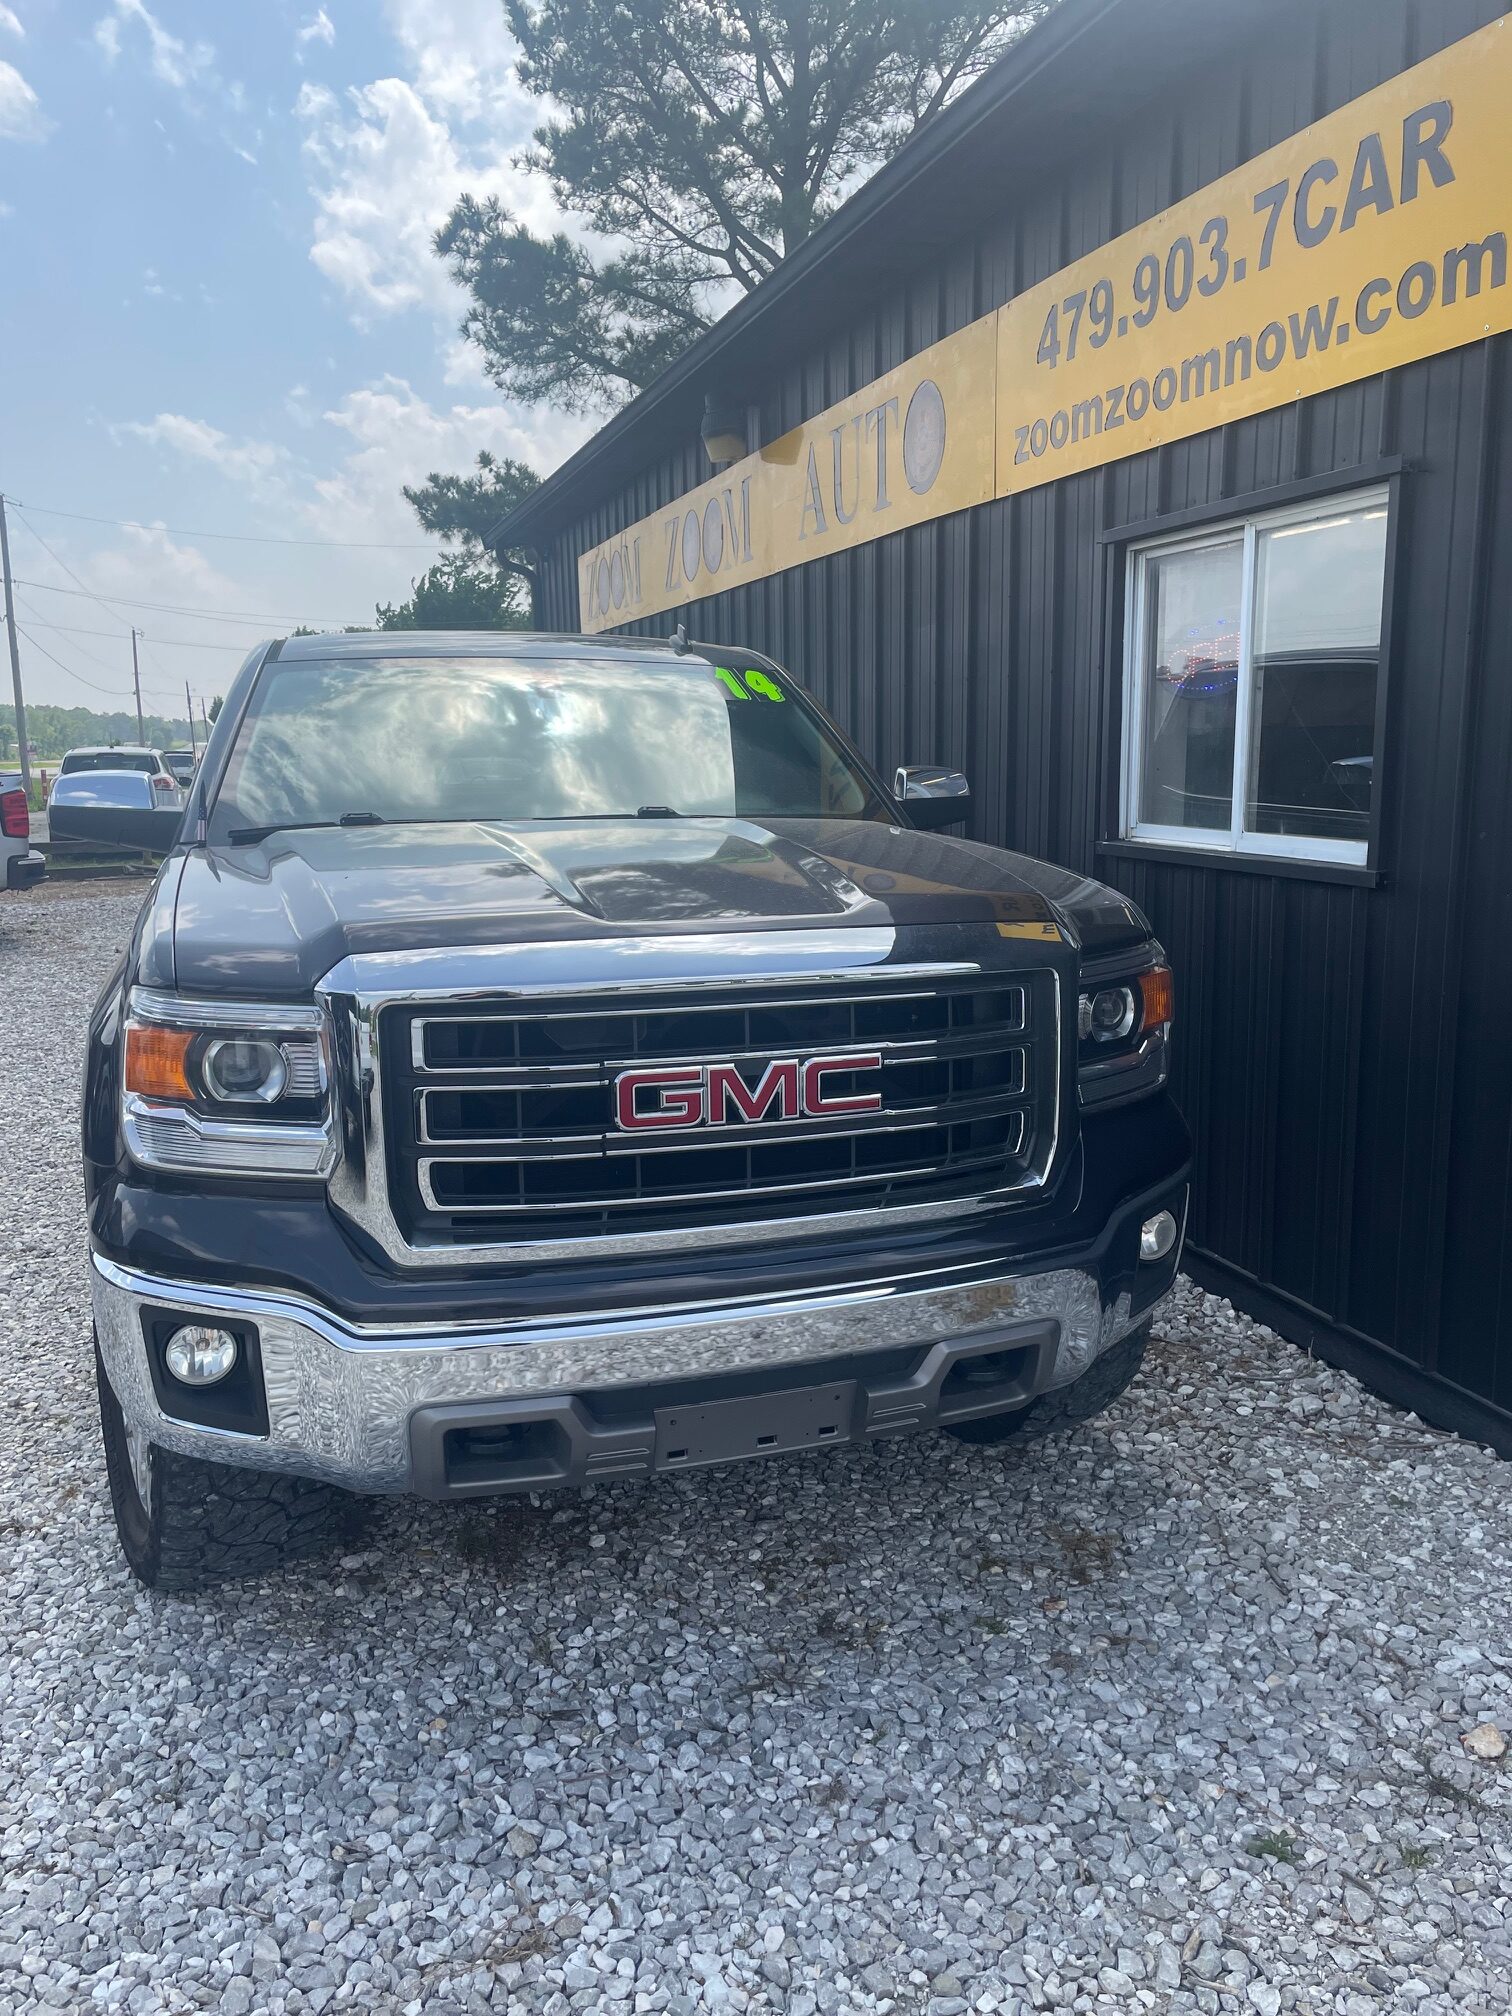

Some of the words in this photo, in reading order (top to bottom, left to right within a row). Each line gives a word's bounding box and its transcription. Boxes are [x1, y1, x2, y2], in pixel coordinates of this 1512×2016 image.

[1036, 100, 1456, 370] 479.903.7CAR
[1014, 231, 1507, 465] zoomzoomnow.com
[585, 536, 644, 622] ZOOM
[664, 474, 754, 593] ZOOM
[798, 379, 947, 541] AUTO
[714, 666, 786, 703] 14
[1165, 631, 1240, 684] OPE
[614, 1052, 882, 1132] GMC
